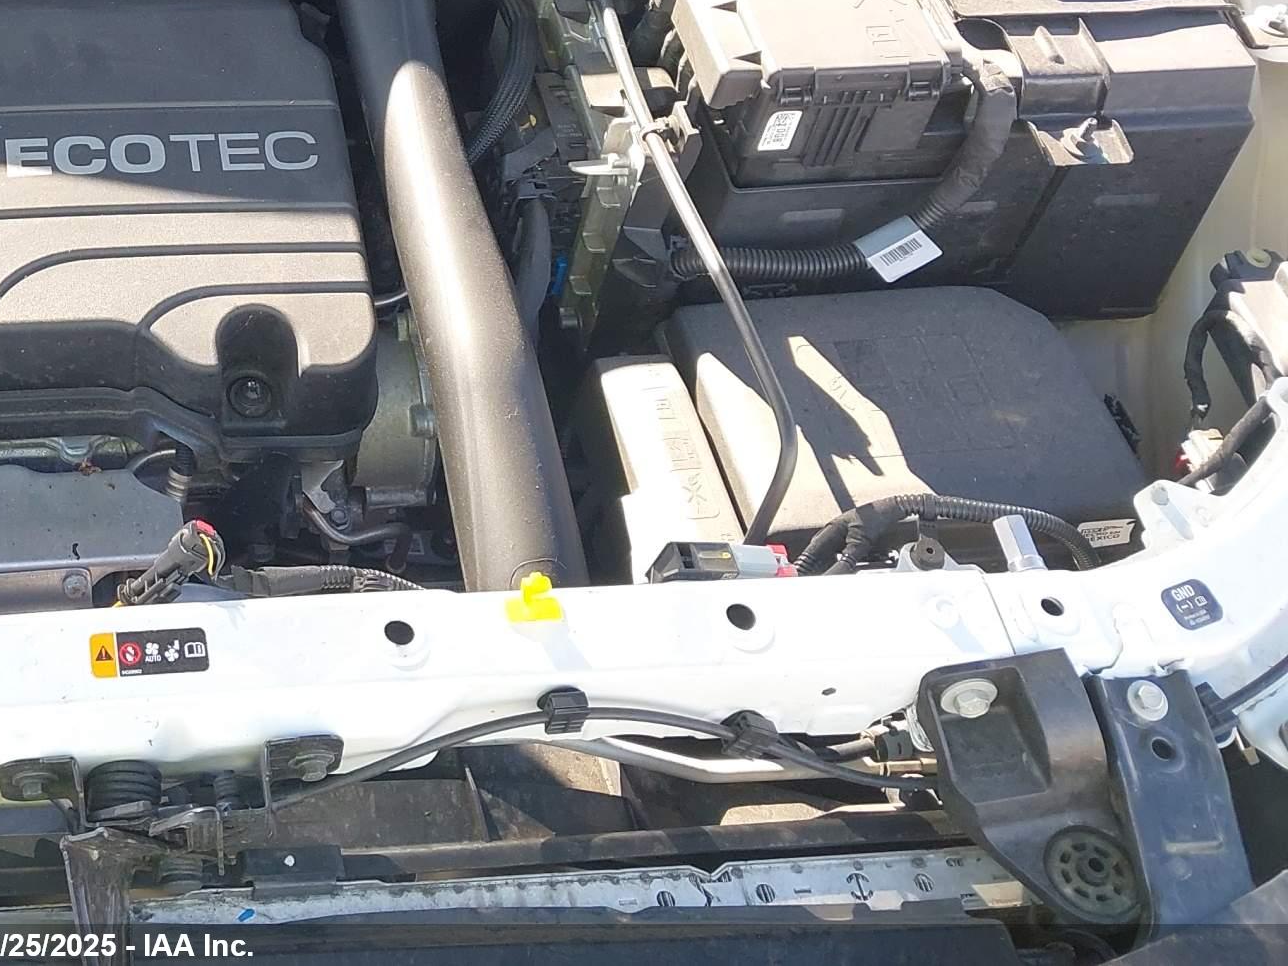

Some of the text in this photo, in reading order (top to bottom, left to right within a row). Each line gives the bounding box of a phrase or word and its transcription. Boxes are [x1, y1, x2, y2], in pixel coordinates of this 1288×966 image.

[5, 131, 319, 178] ECOTEC
[1171, 585, 1196, 601] GND
[145, 654, 162, 662] AUTO
